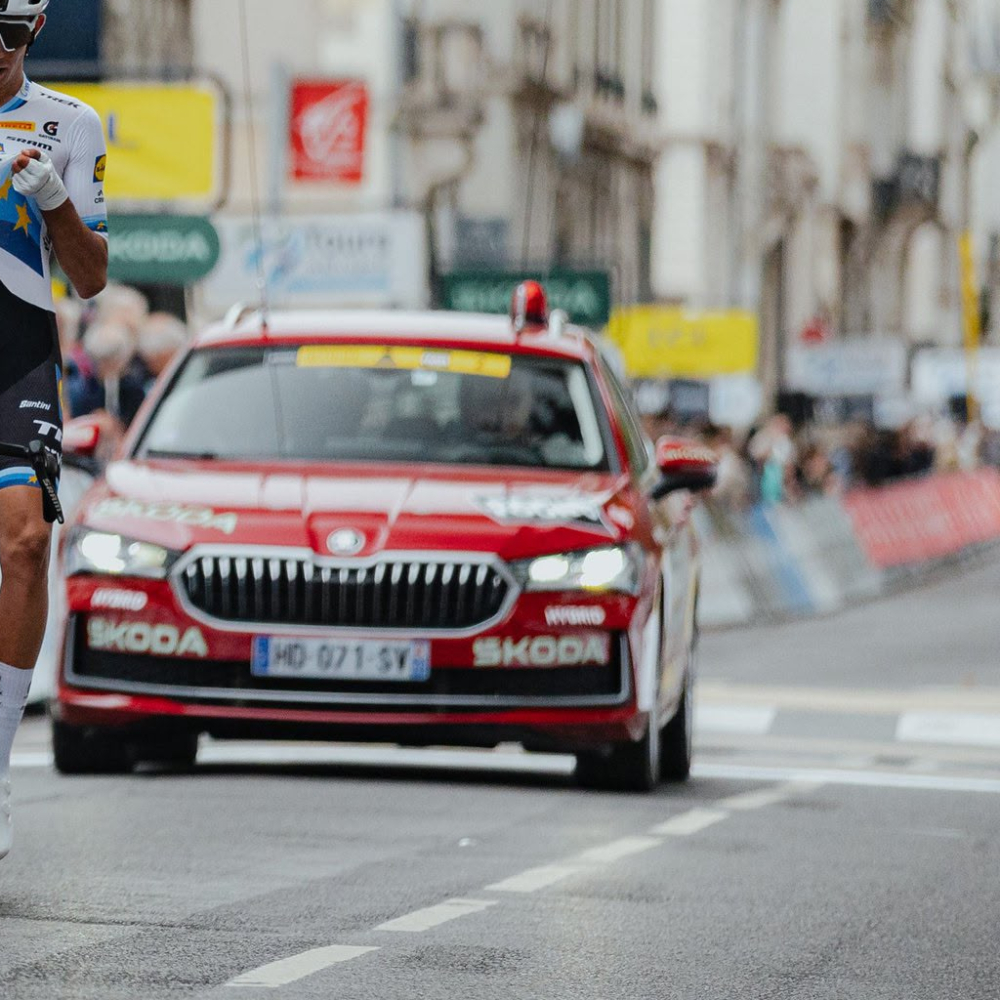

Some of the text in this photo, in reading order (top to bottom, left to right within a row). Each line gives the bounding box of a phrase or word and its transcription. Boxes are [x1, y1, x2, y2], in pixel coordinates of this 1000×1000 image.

[39, 91, 81, 109] TREK
[5, 135, 54, 152] SRAM
[19, 399, 51, 411] Santini
[42, 478, 63, 512] SRAM
